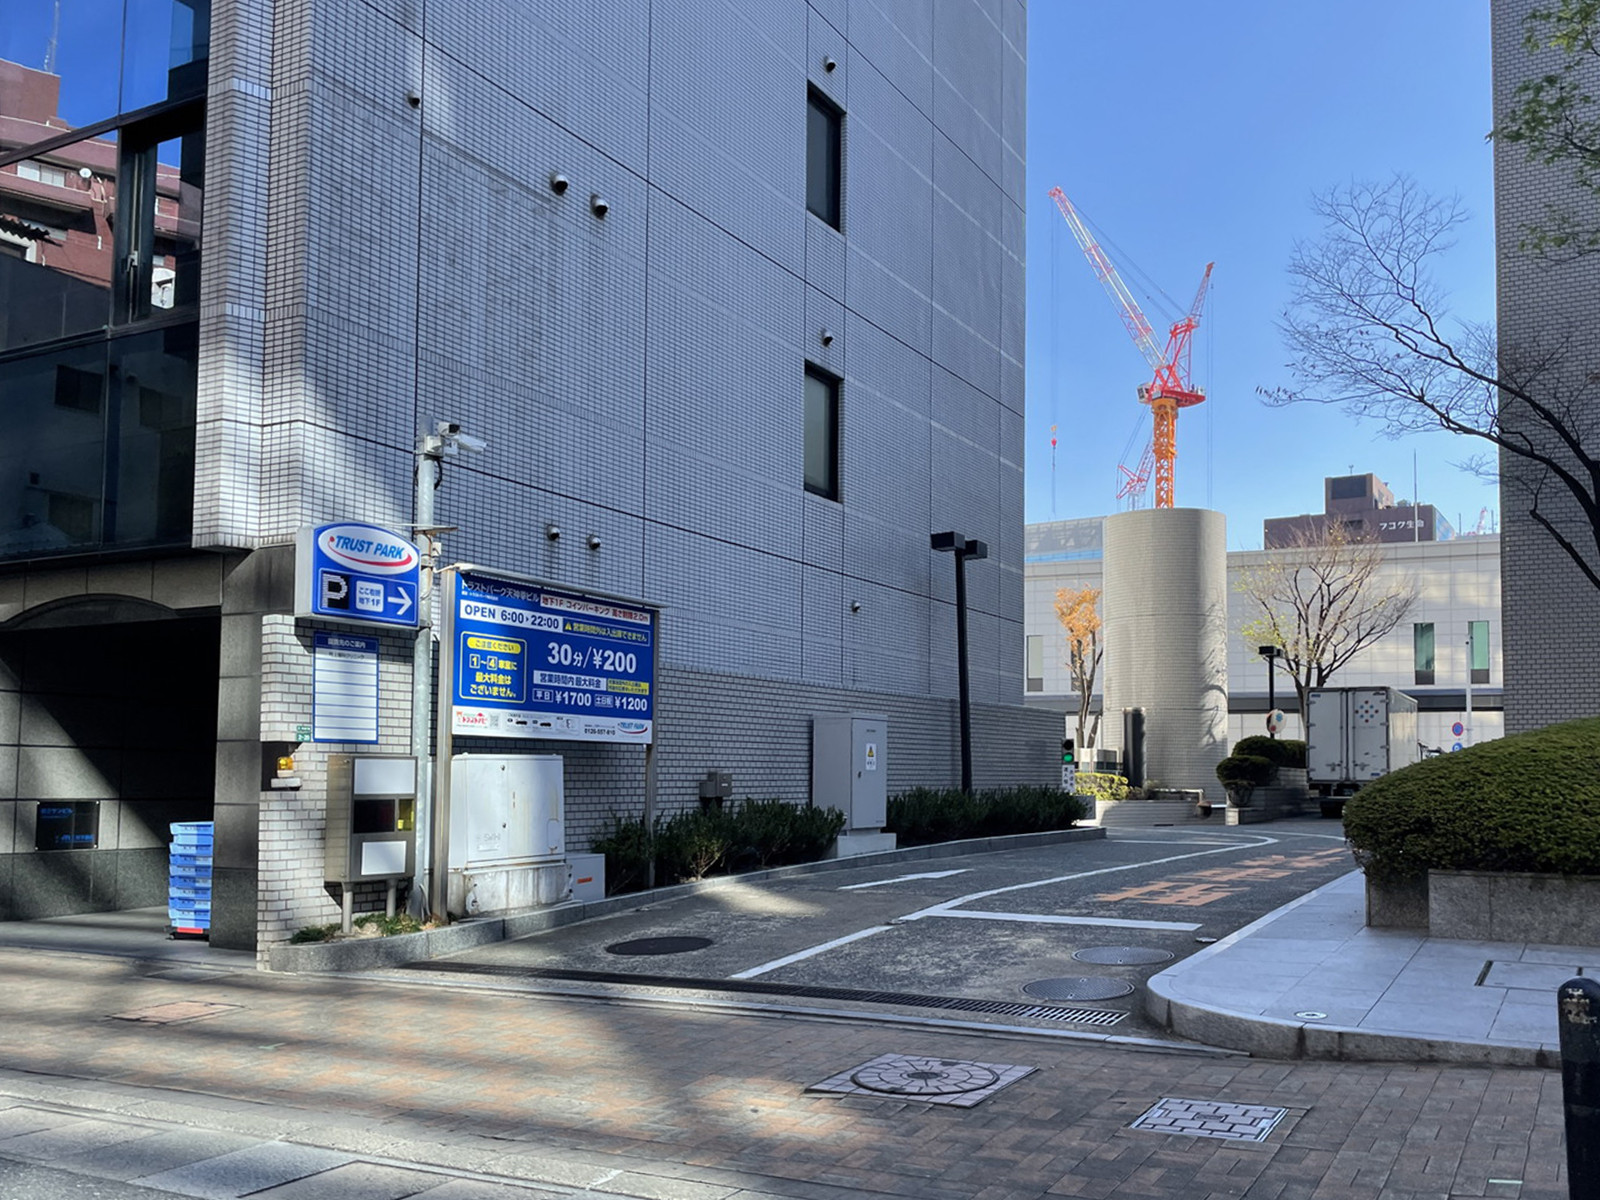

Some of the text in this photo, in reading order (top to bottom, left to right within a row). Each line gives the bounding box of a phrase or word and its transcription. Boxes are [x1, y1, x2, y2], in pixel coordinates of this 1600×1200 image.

[335, 536, 404, 559] TRUST PARK
[322, 573, 348, 608] P
[359, 598, 381, 607] 地下1F
[464, 604, 496, 619] OPEN
[555, 690, 591, 706] ¥1700
[615, 696, 648, 711] ¥1200
